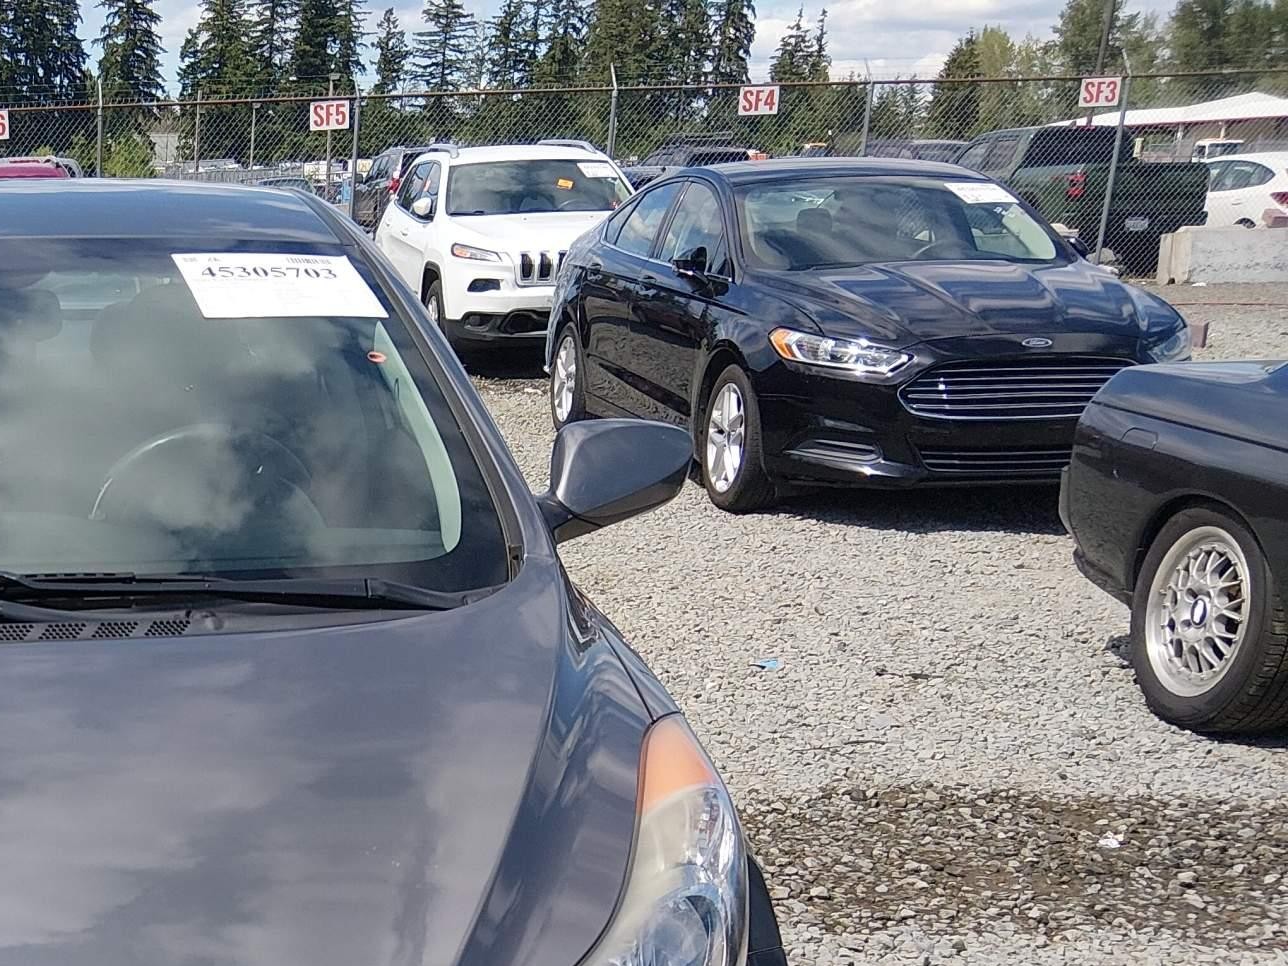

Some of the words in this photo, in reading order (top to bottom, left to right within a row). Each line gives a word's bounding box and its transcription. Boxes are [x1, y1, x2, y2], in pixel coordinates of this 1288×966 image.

[742, 90, 776, 113] SF4
[1083, 80, 1117, 104] SF3
[313, 103, 347, 127] SF5
[201, 266, 338, 280] 45305703
